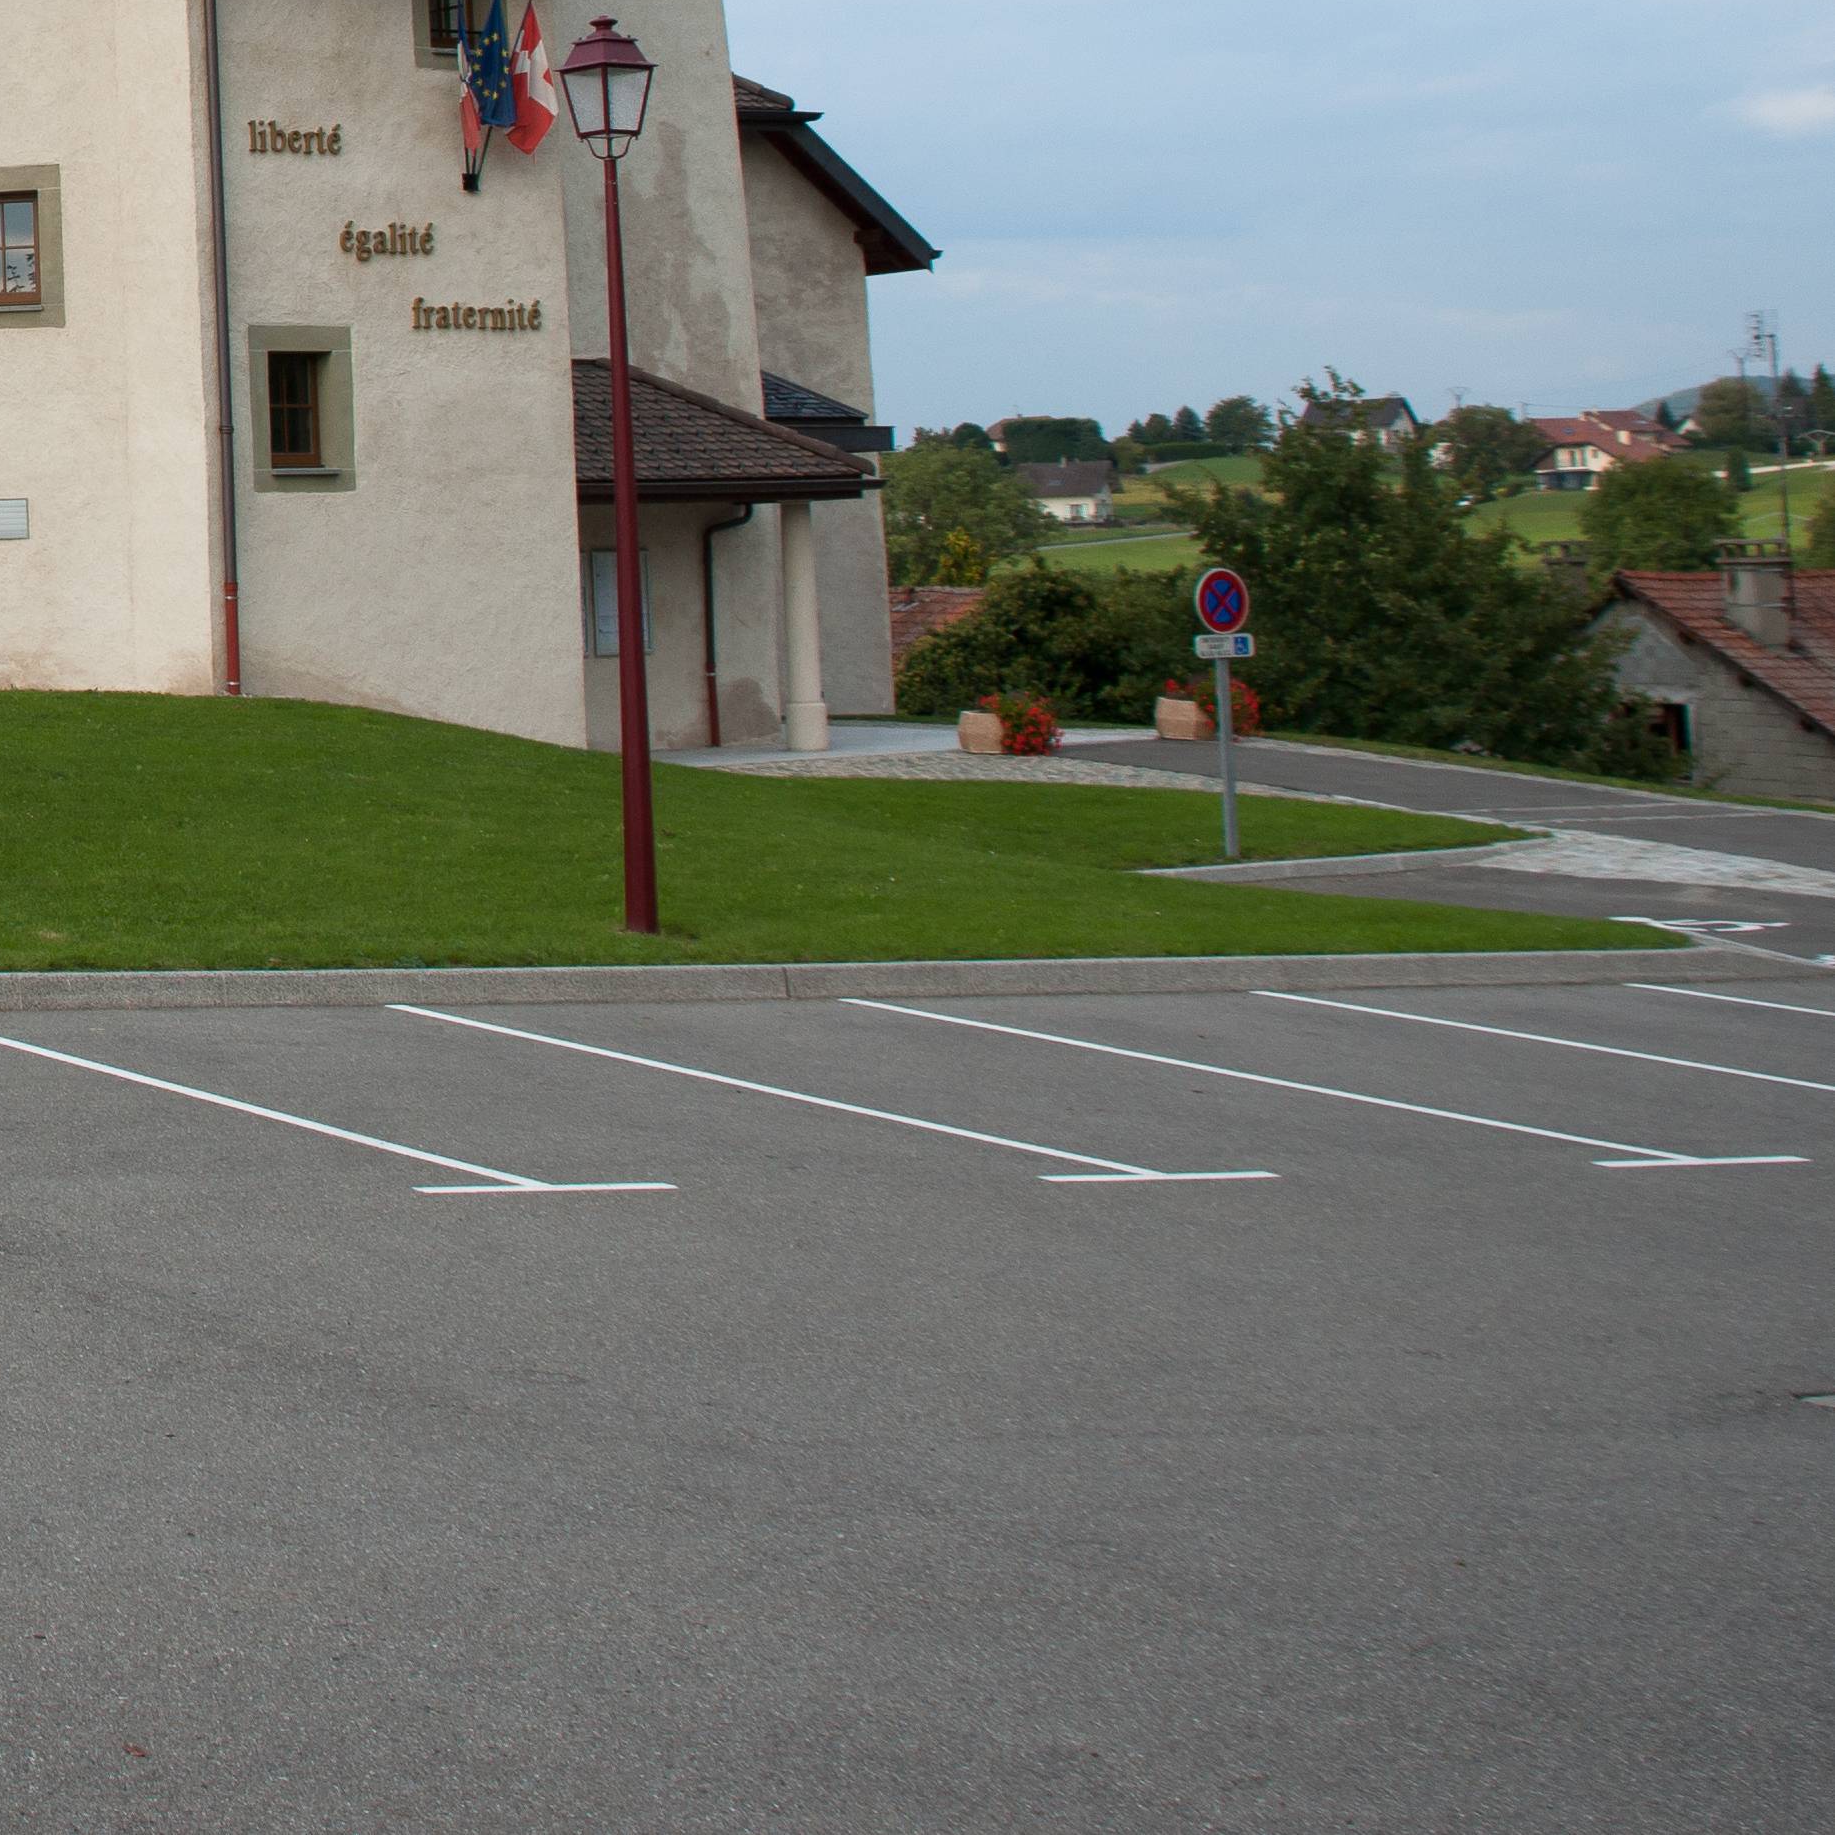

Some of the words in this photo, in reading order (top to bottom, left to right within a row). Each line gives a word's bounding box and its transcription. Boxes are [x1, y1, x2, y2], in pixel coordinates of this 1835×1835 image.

[247, 119, 343, 156] liberté
[339, 219, 434, 263] égalité
[411, 296, 542, 331] fraternité
